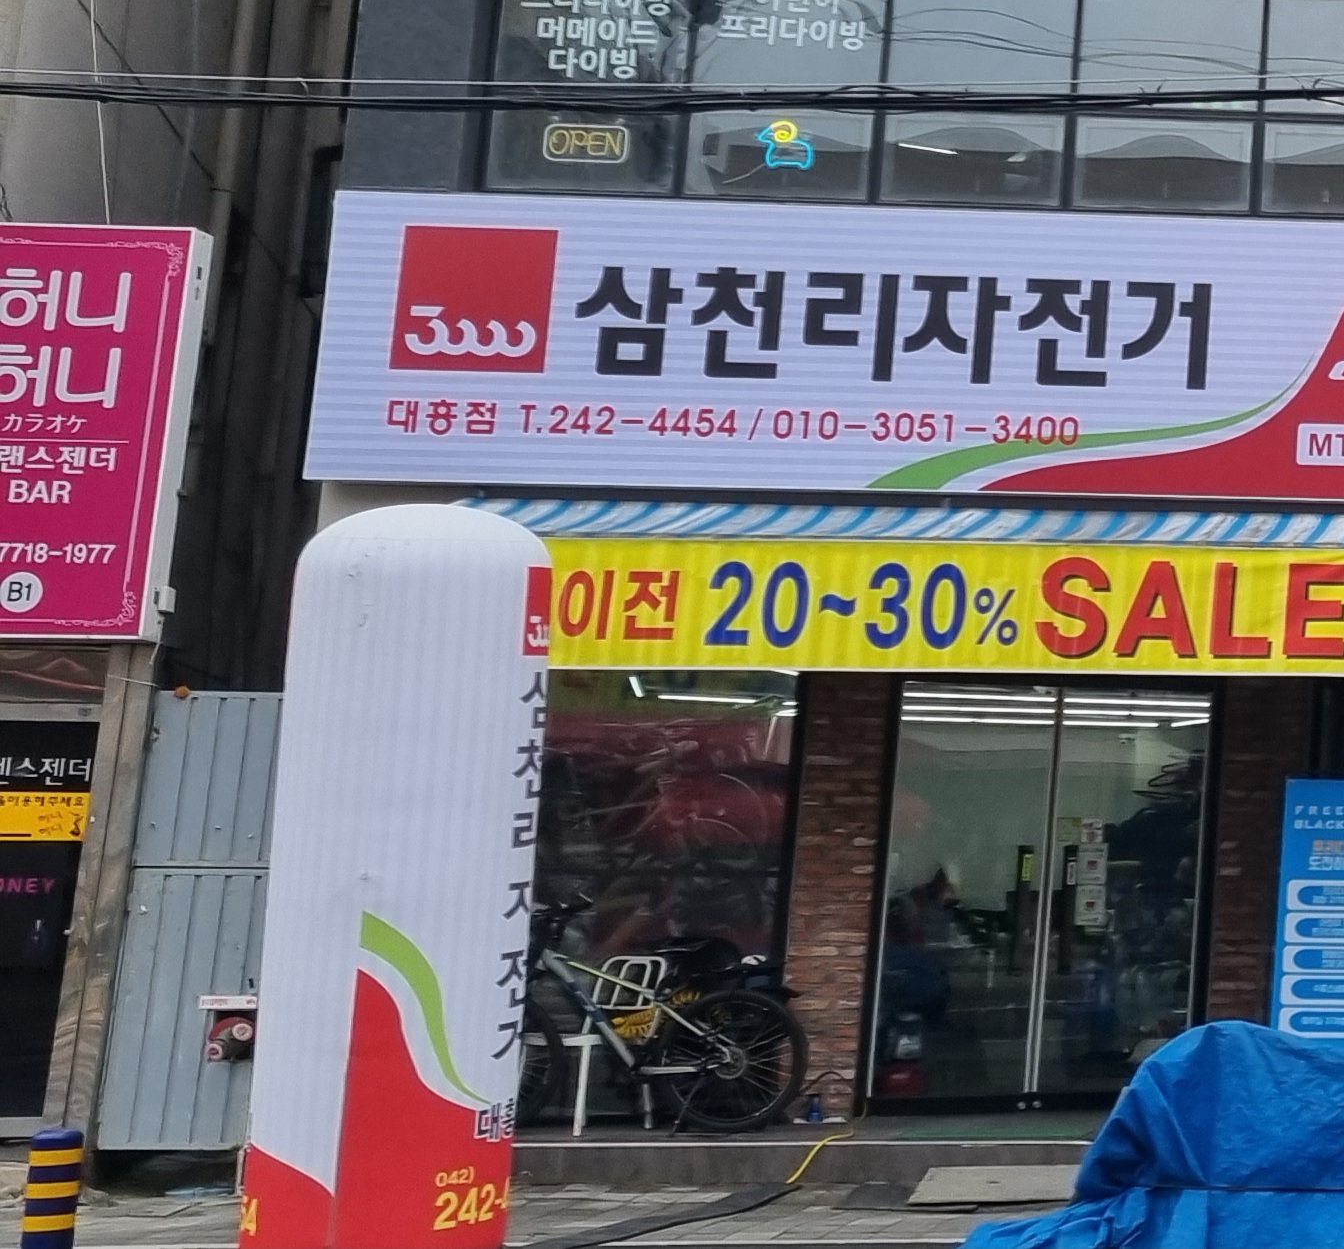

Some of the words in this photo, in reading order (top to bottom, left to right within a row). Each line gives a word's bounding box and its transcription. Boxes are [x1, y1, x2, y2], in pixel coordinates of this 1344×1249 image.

[537, 16, 658, 48] 머메이드
[717, 14, 867, 51] 프리다이빙
[548, 48, 638, 79] 다이빙
[550, 129, 624, 156] OPEN
[0, 268, 132, 333] 허니
[576, 265, 1213, 390] 삼천리자전거
[0, 344, 122, 409] 허니
[1, 412, 88, 434] カラオケ
[387, 398, 498, 437] 대흥점
[7, 480, 72, 504] BAR
[6, 581, 34, 603] B1
[557, 569, 682, 641] 이전
[704, 559, 1018, 649] 20~30%
